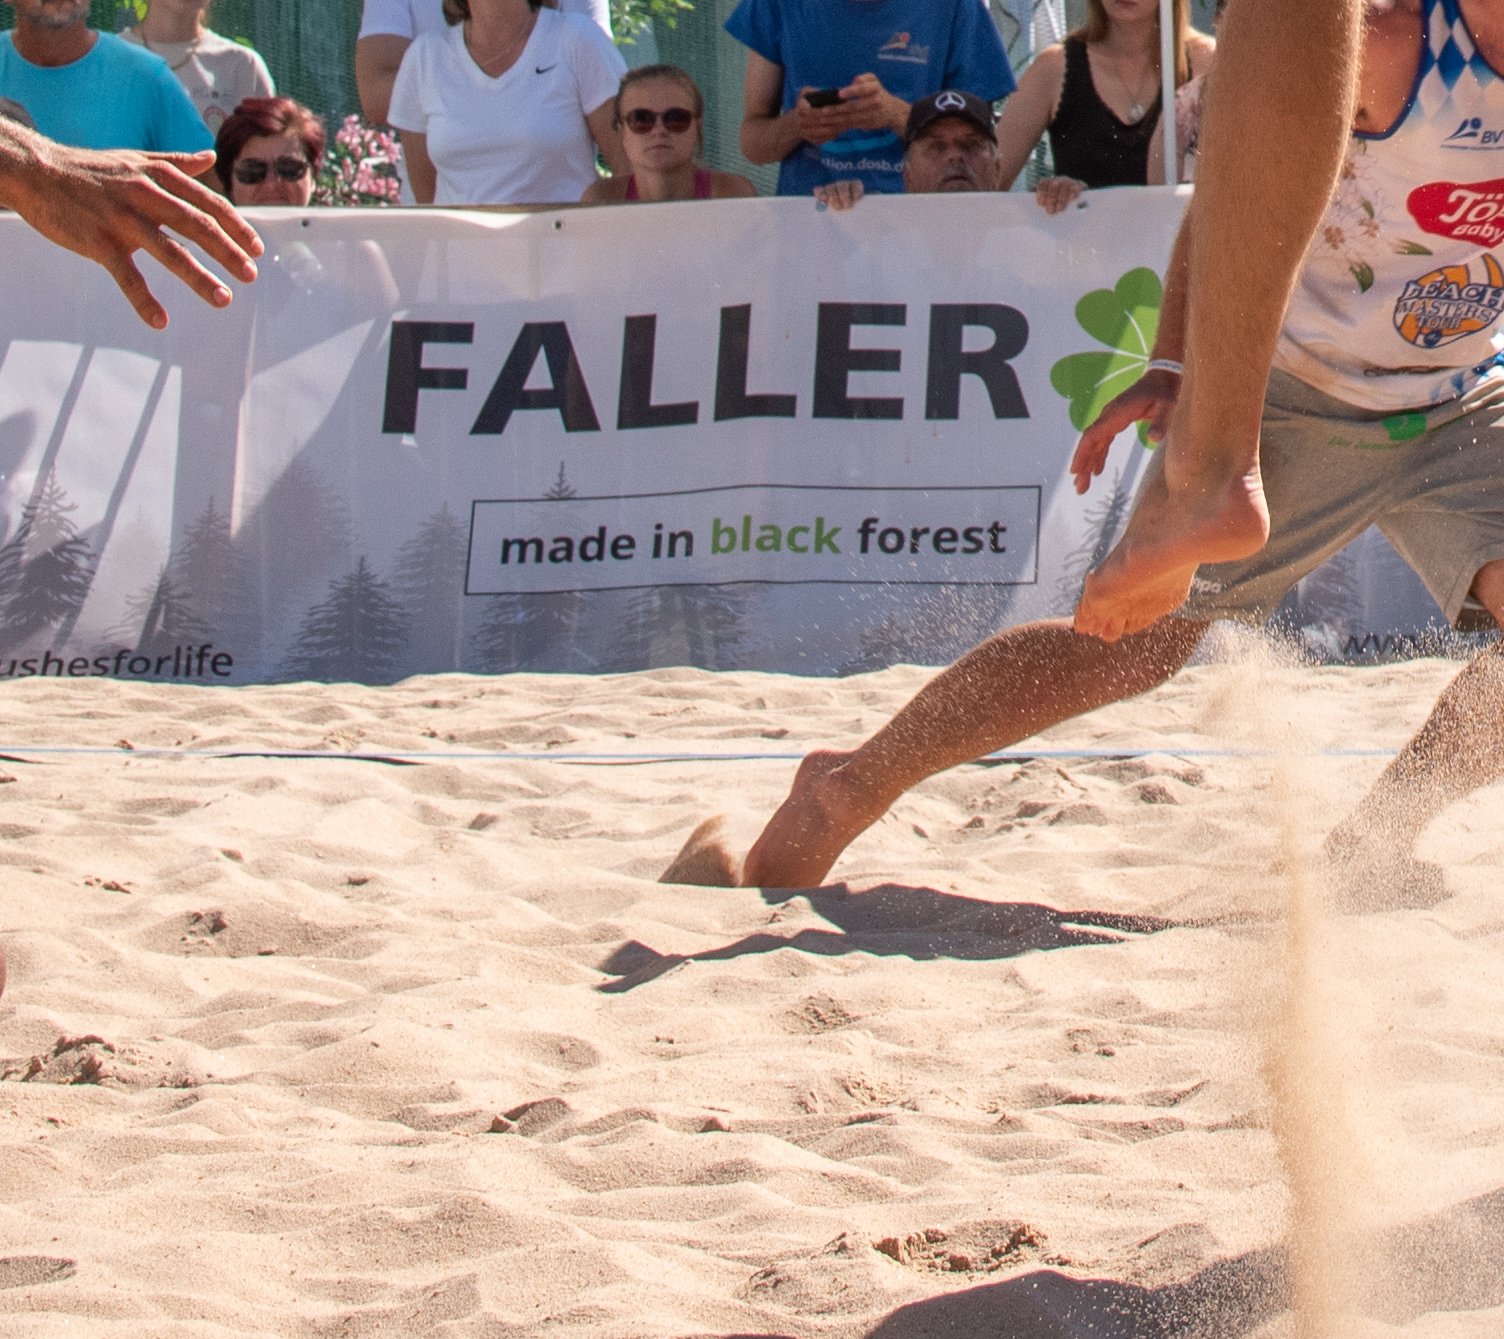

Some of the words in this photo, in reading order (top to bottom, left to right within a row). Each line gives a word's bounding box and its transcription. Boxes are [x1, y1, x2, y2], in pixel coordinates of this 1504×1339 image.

[381, 302, 1032, 436] FALLER
[499, 522, 637, 567] made
[652, 523, 695, 560] in
[709, 513, 842, 559] black
[855, 515, 1009, 557] forest
